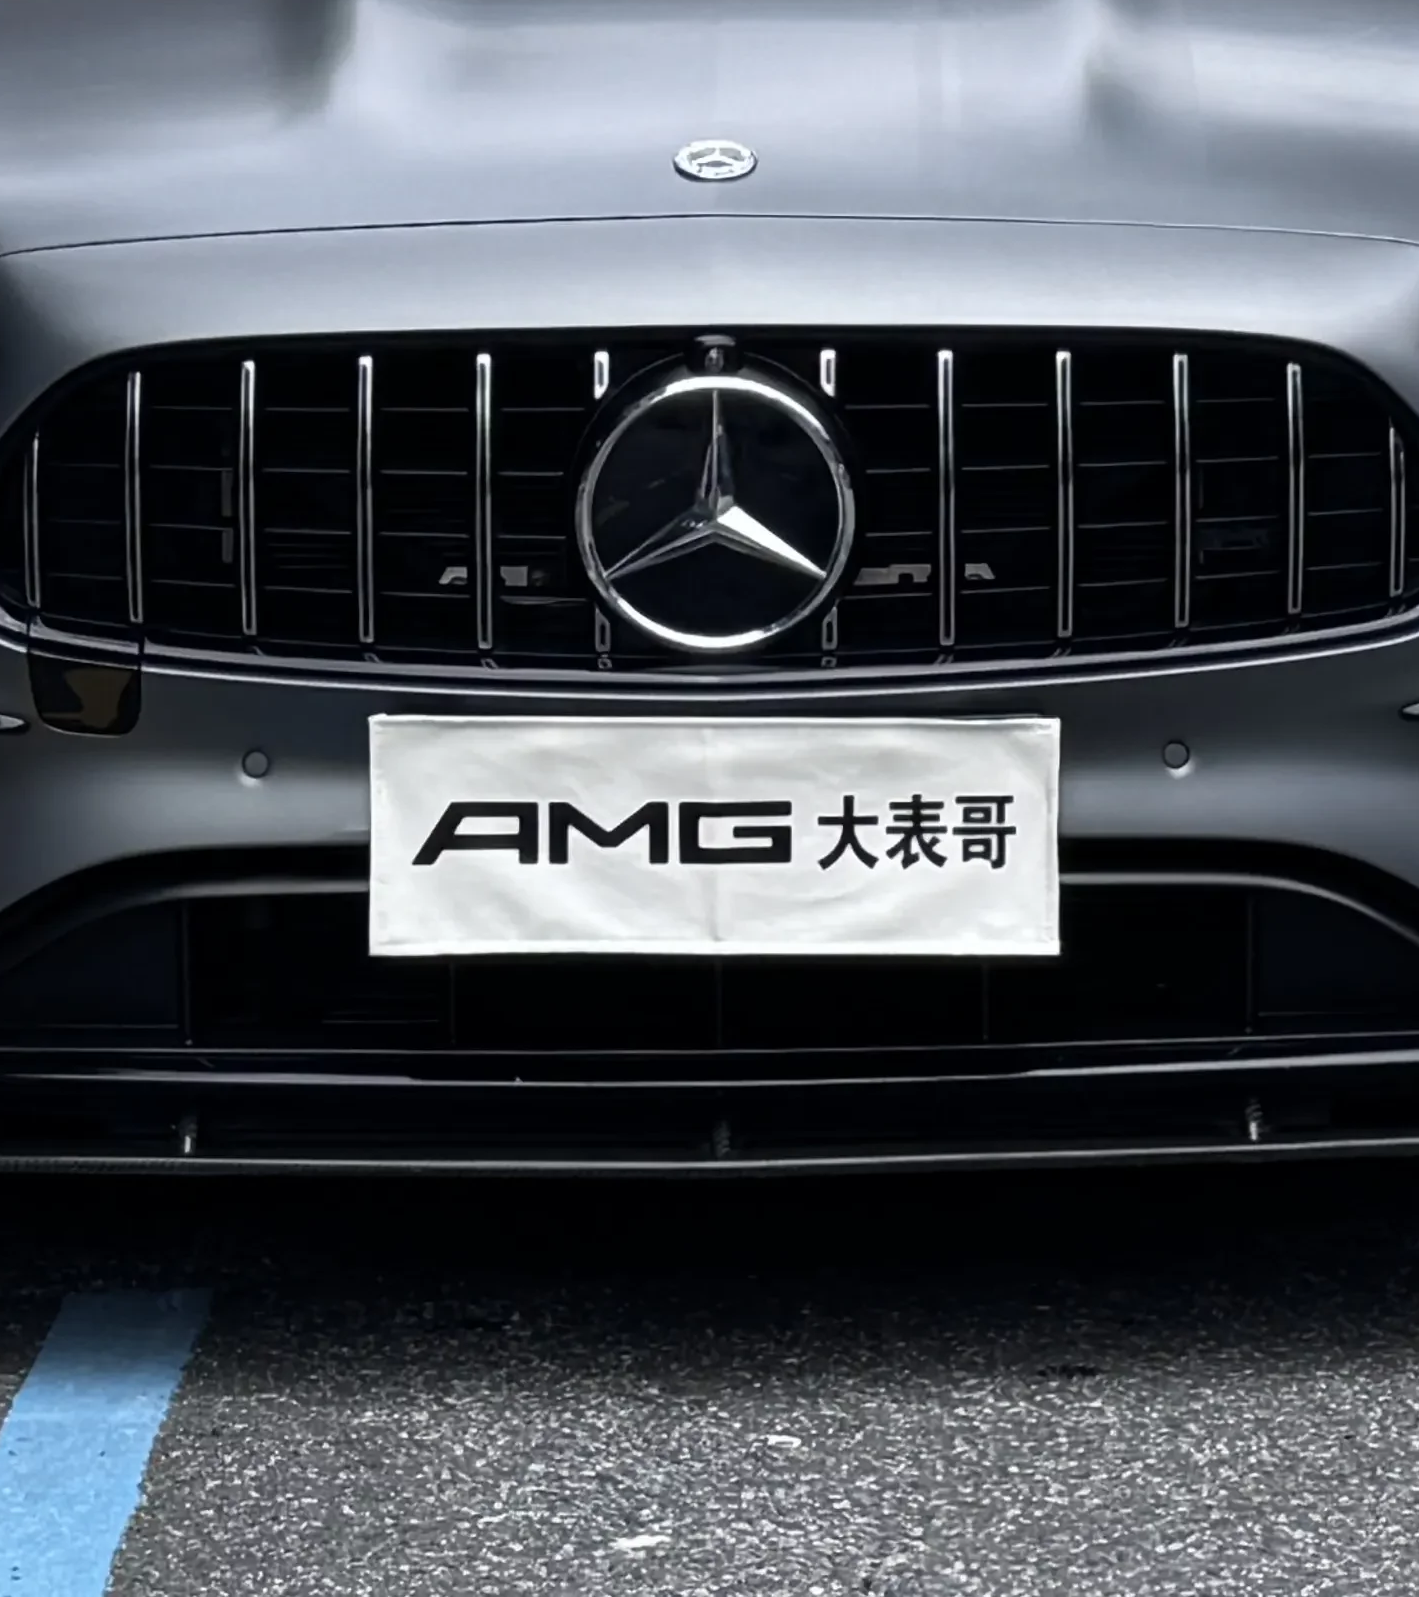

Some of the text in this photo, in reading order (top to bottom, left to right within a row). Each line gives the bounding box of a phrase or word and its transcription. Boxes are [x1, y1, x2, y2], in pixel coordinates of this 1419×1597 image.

[412, 793, 1018, 871] AMG 大表哥
